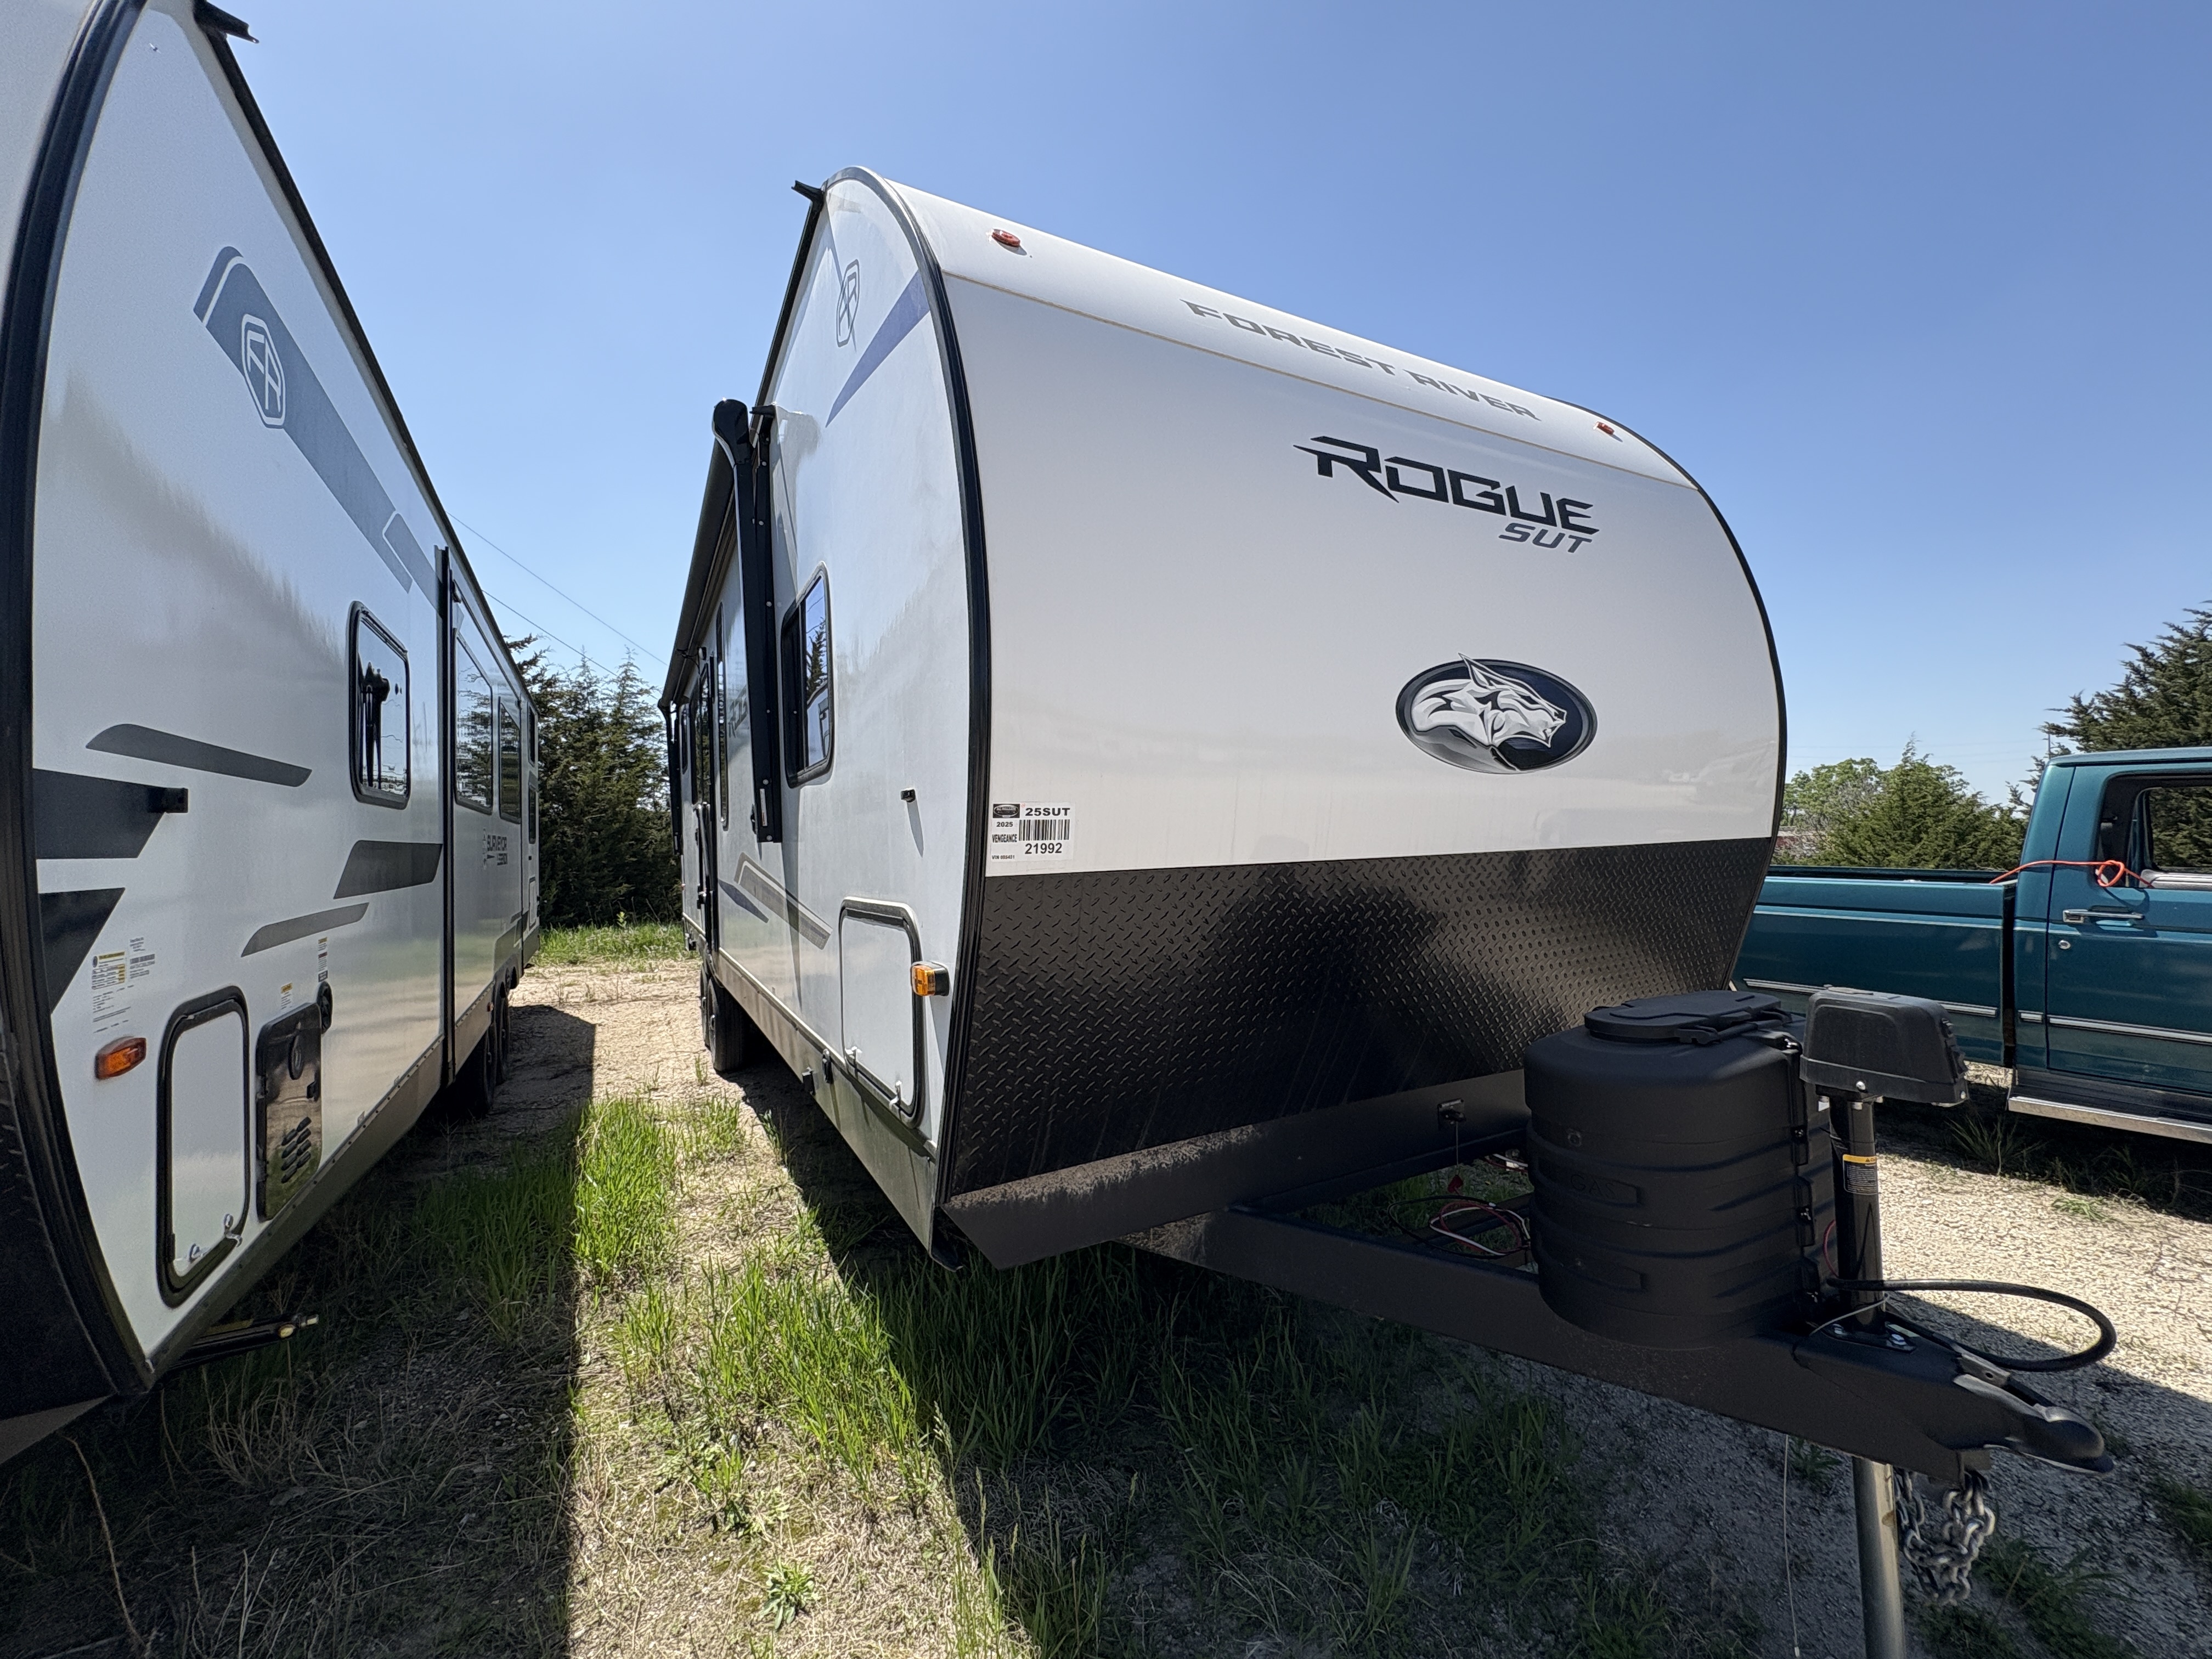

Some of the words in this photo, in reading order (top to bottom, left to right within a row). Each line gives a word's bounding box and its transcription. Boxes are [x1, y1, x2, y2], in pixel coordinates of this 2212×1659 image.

[1180, 298, 1396, 376] FOREST
[1402, 369, 1542, 421] RIVER
[1293, 435, 1600, 535] ROGUE
[1498, 522, 1593, 554] SUT
[1025, 808, 1070, 816] 25SUT
[992, 834, 1018, 843] VENGEANCE
[1025, 843, 1062, 854] 21992
[1570, 1173, 1616, 1198] GAS
